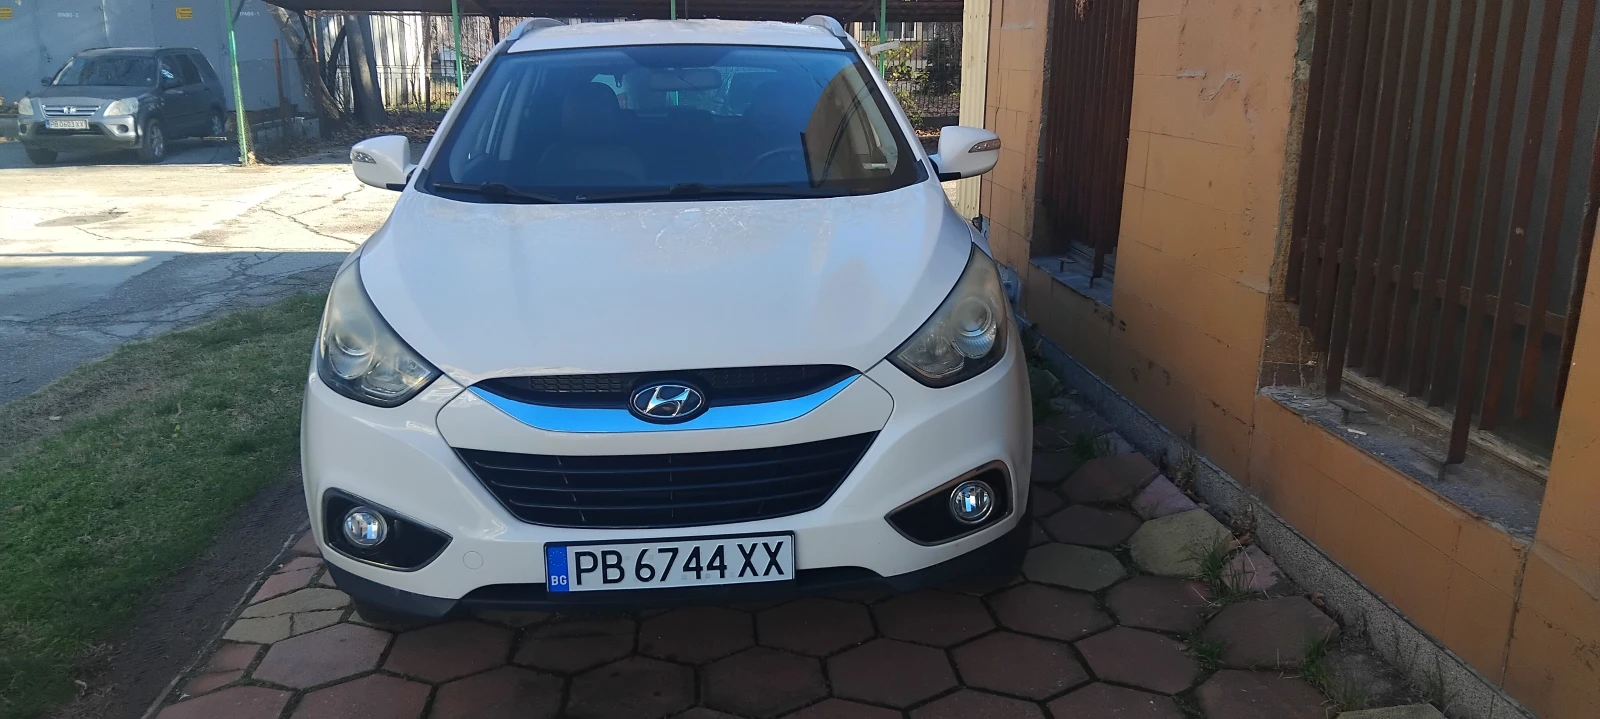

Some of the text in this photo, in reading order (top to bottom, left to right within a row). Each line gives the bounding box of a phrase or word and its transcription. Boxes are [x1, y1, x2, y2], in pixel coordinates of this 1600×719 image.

[574, 541, 785, 586] PB 6744 XX
[551, 575, 568, 586] BG
